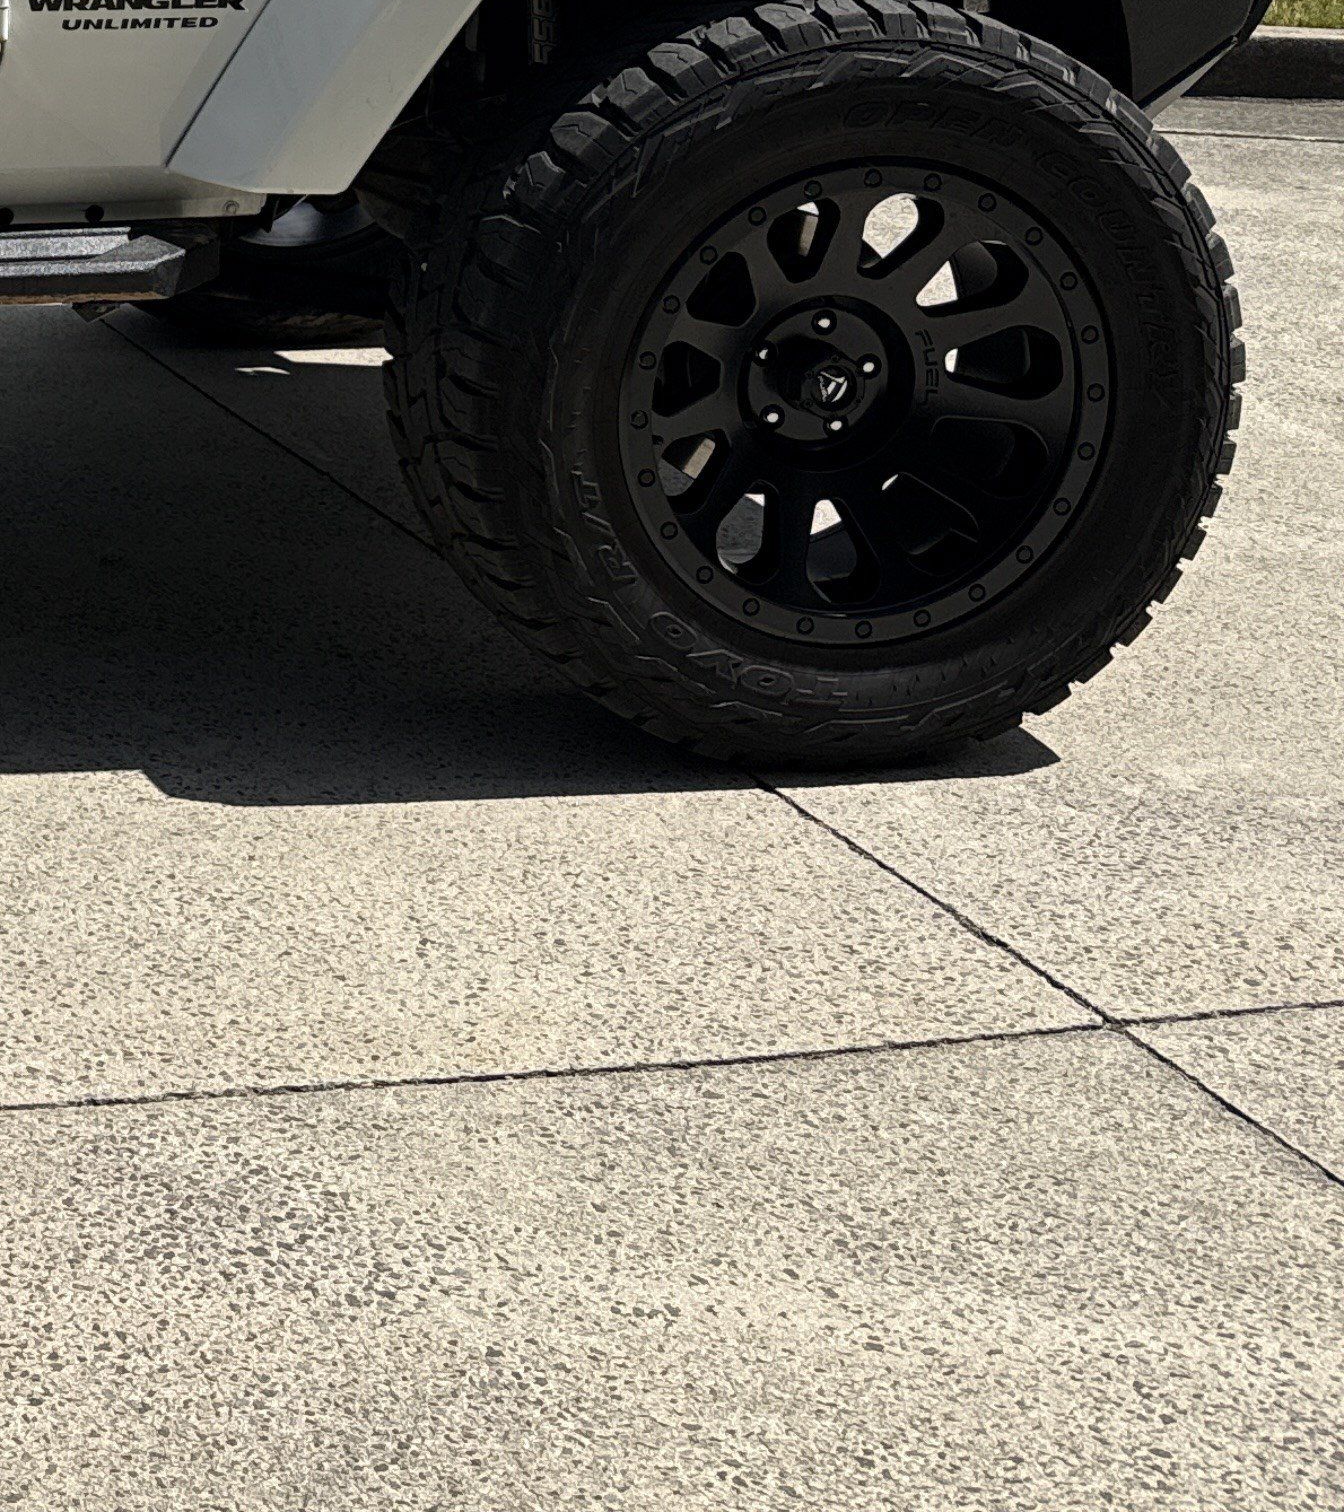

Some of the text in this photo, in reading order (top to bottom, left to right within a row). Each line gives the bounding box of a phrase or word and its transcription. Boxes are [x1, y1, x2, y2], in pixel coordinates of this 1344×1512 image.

[61, 15, 219, 31] UNLIMITED
[913, 328, 940, 410] FUEL
[648, 610, 848, 708] TOYO
